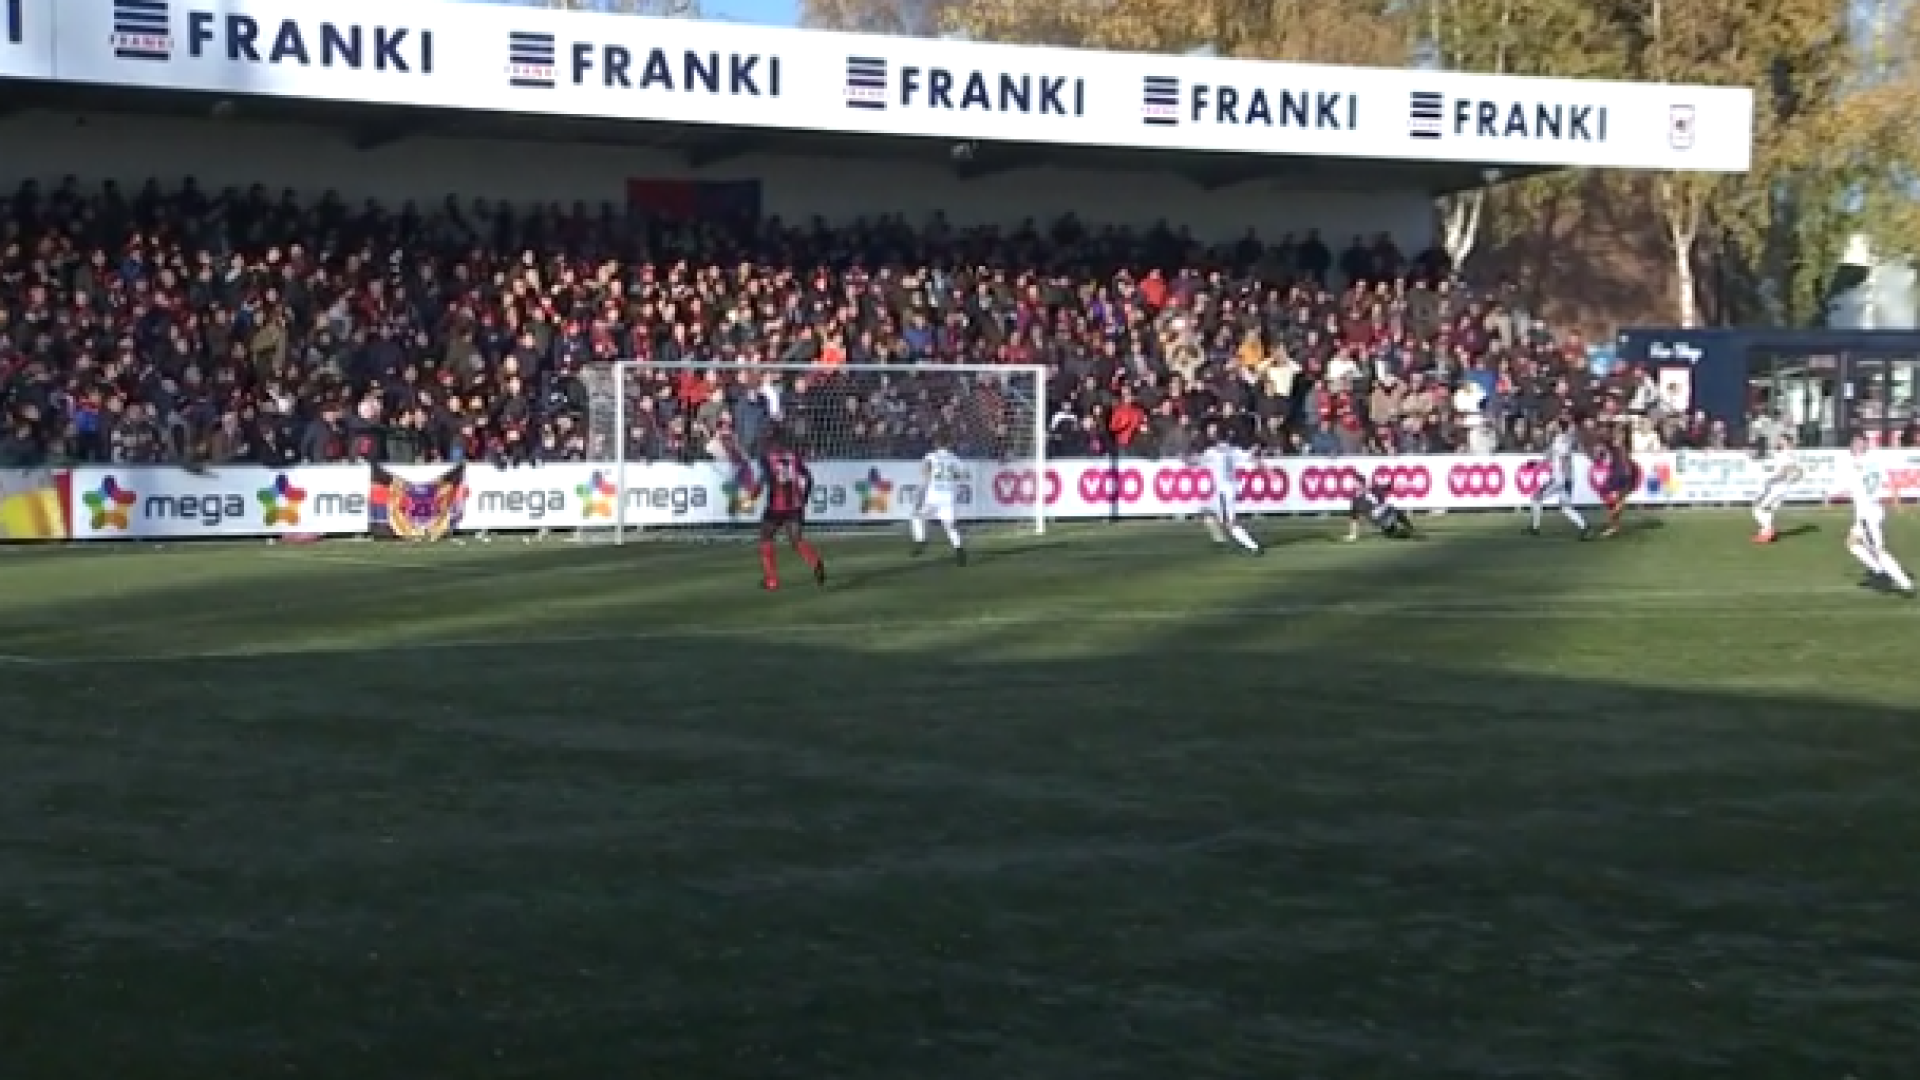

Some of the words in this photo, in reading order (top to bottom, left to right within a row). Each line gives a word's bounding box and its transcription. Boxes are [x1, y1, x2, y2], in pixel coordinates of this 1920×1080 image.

[189, 12, 432, 74] FRANKI
[572, 43, 780, 96] FRANKI
[902, 66, 1084, 115] FRANKI
[1193, 85, 1357, 128] FRANKI
[1456, 100, 1605, 140] FRANKI
[144, 492, 244, 525] mega
[313, 490, 366, 516] me
[478, 486, 565, 519] mega
[625, 482, 707, 515] mega
[811, 483, 847, 514] ga
